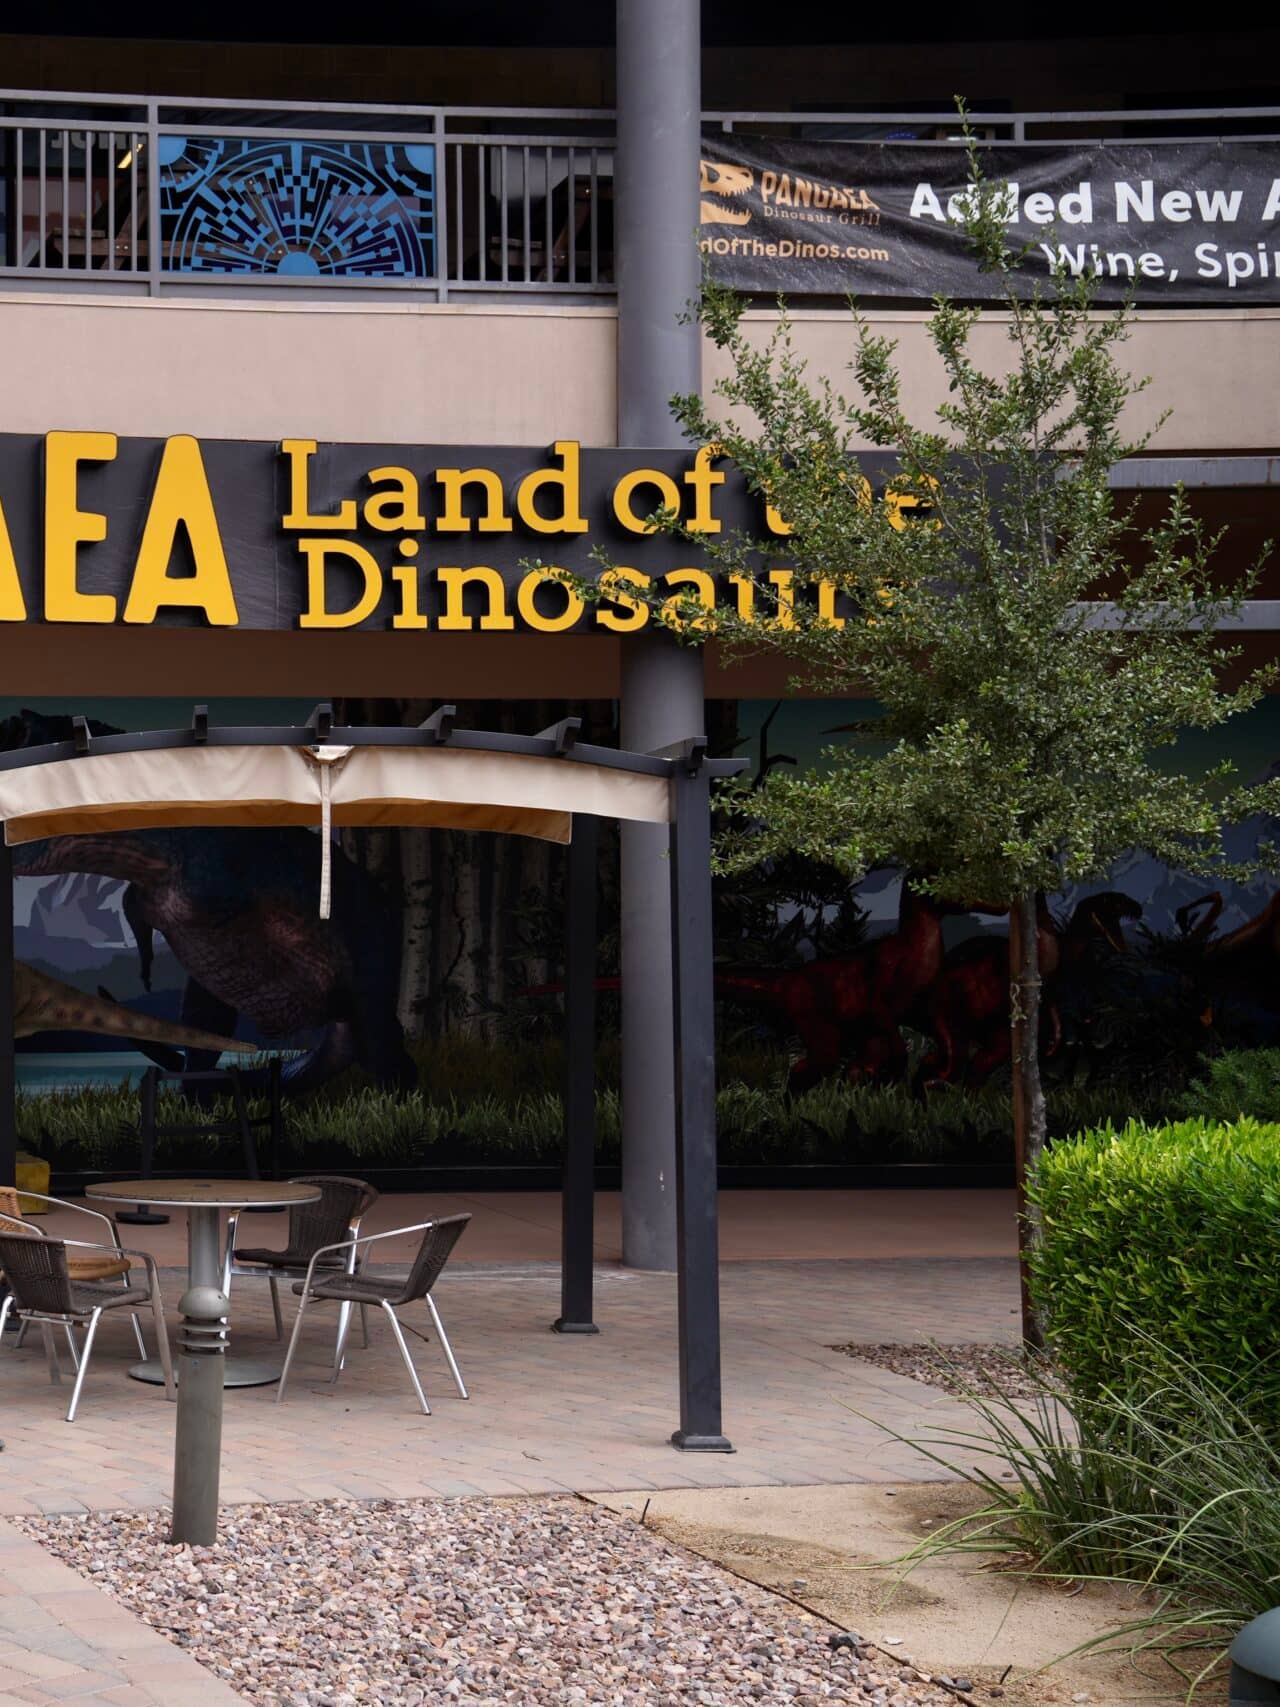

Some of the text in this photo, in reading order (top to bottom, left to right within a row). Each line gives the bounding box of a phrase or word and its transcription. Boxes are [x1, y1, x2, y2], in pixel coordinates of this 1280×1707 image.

[760, 170, 881, 211] PANGAEA
[909, 182, 1094, 225] Added
[1114, 180, 1244, 223] New
[764, 204, 881, 227] Dinosaur Grill
[1039, 243, 1179, 282] Wine,
[281, 438, 589, 534] Land
[612, 441, 730, 536] of
[298, 537, 920, 633] Dinosaur
